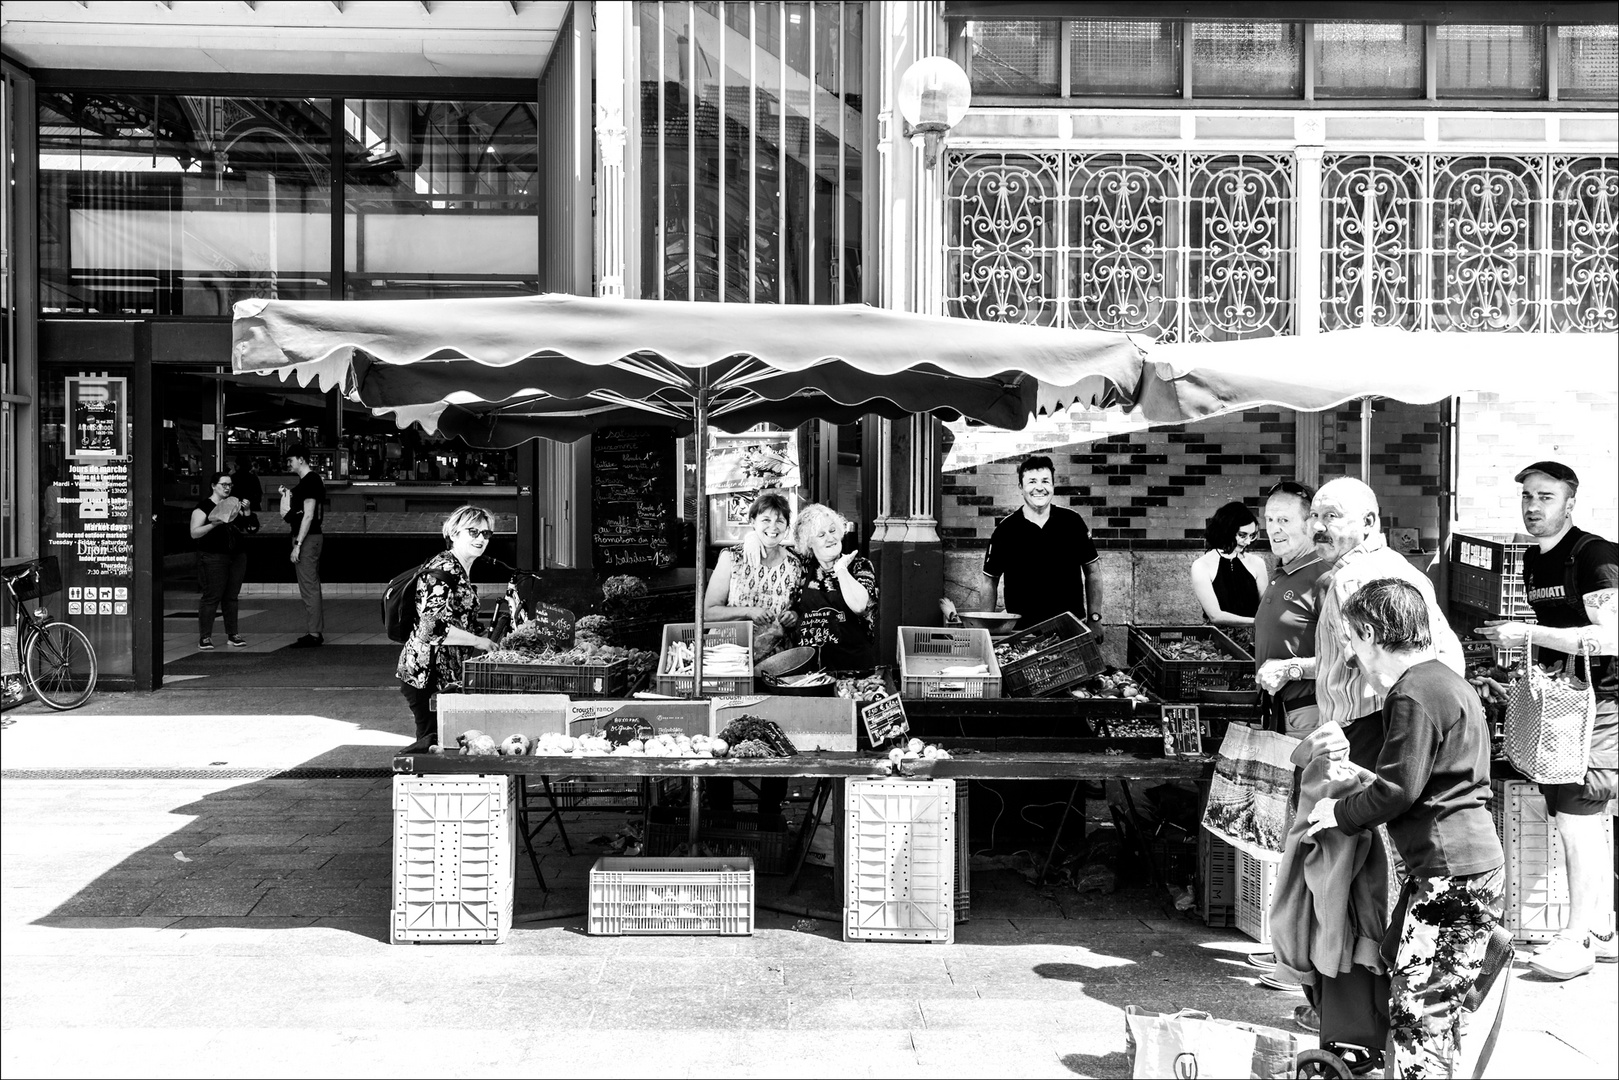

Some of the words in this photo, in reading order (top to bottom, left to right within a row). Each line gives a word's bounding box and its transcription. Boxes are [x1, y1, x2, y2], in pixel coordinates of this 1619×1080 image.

[70, 465, 89, 473] Jours
[90, 465, 99, 473] de
[100, 465, 127, 473] marché
[84, 522, 110, 531] Market
[110, 522, 128, 532] days
